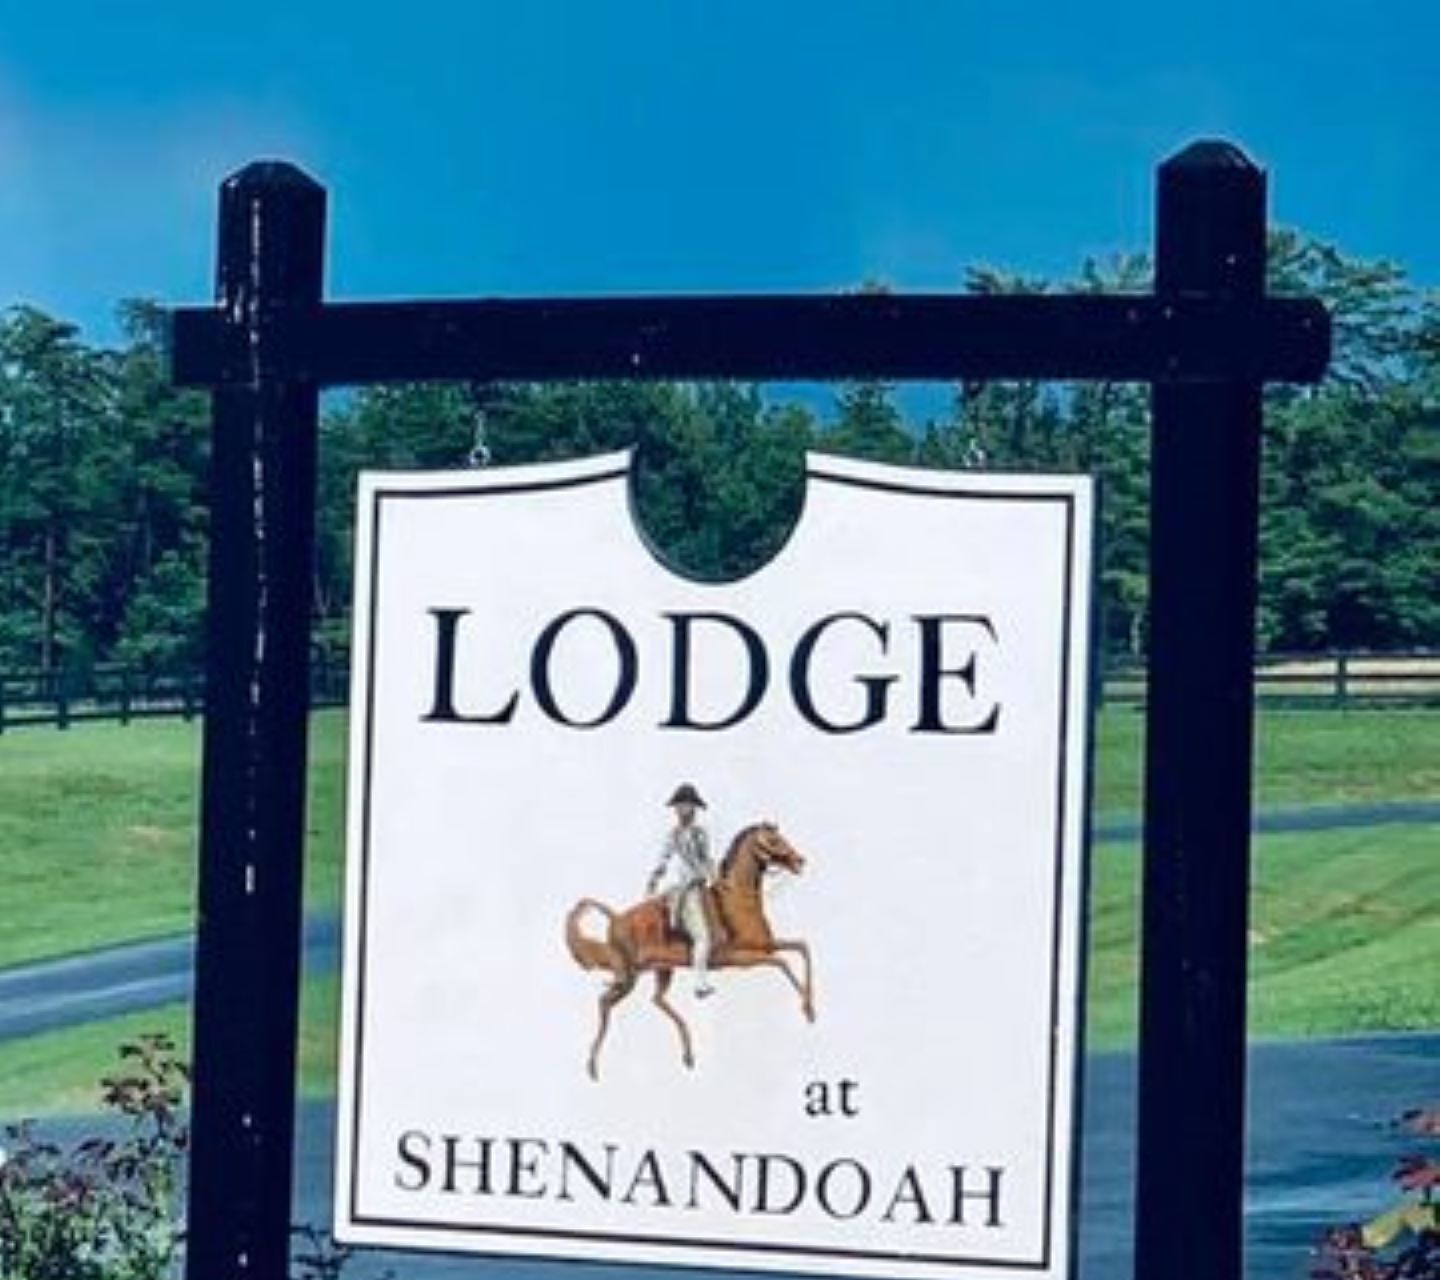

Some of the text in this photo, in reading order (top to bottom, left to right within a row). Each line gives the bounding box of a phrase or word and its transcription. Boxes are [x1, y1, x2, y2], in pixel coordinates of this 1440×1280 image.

[420, 607, 1001, 735] LODGE
[803, 1078, 859, 1118] at
[394, 1131, 1006, 1228] SHENANDOAH
